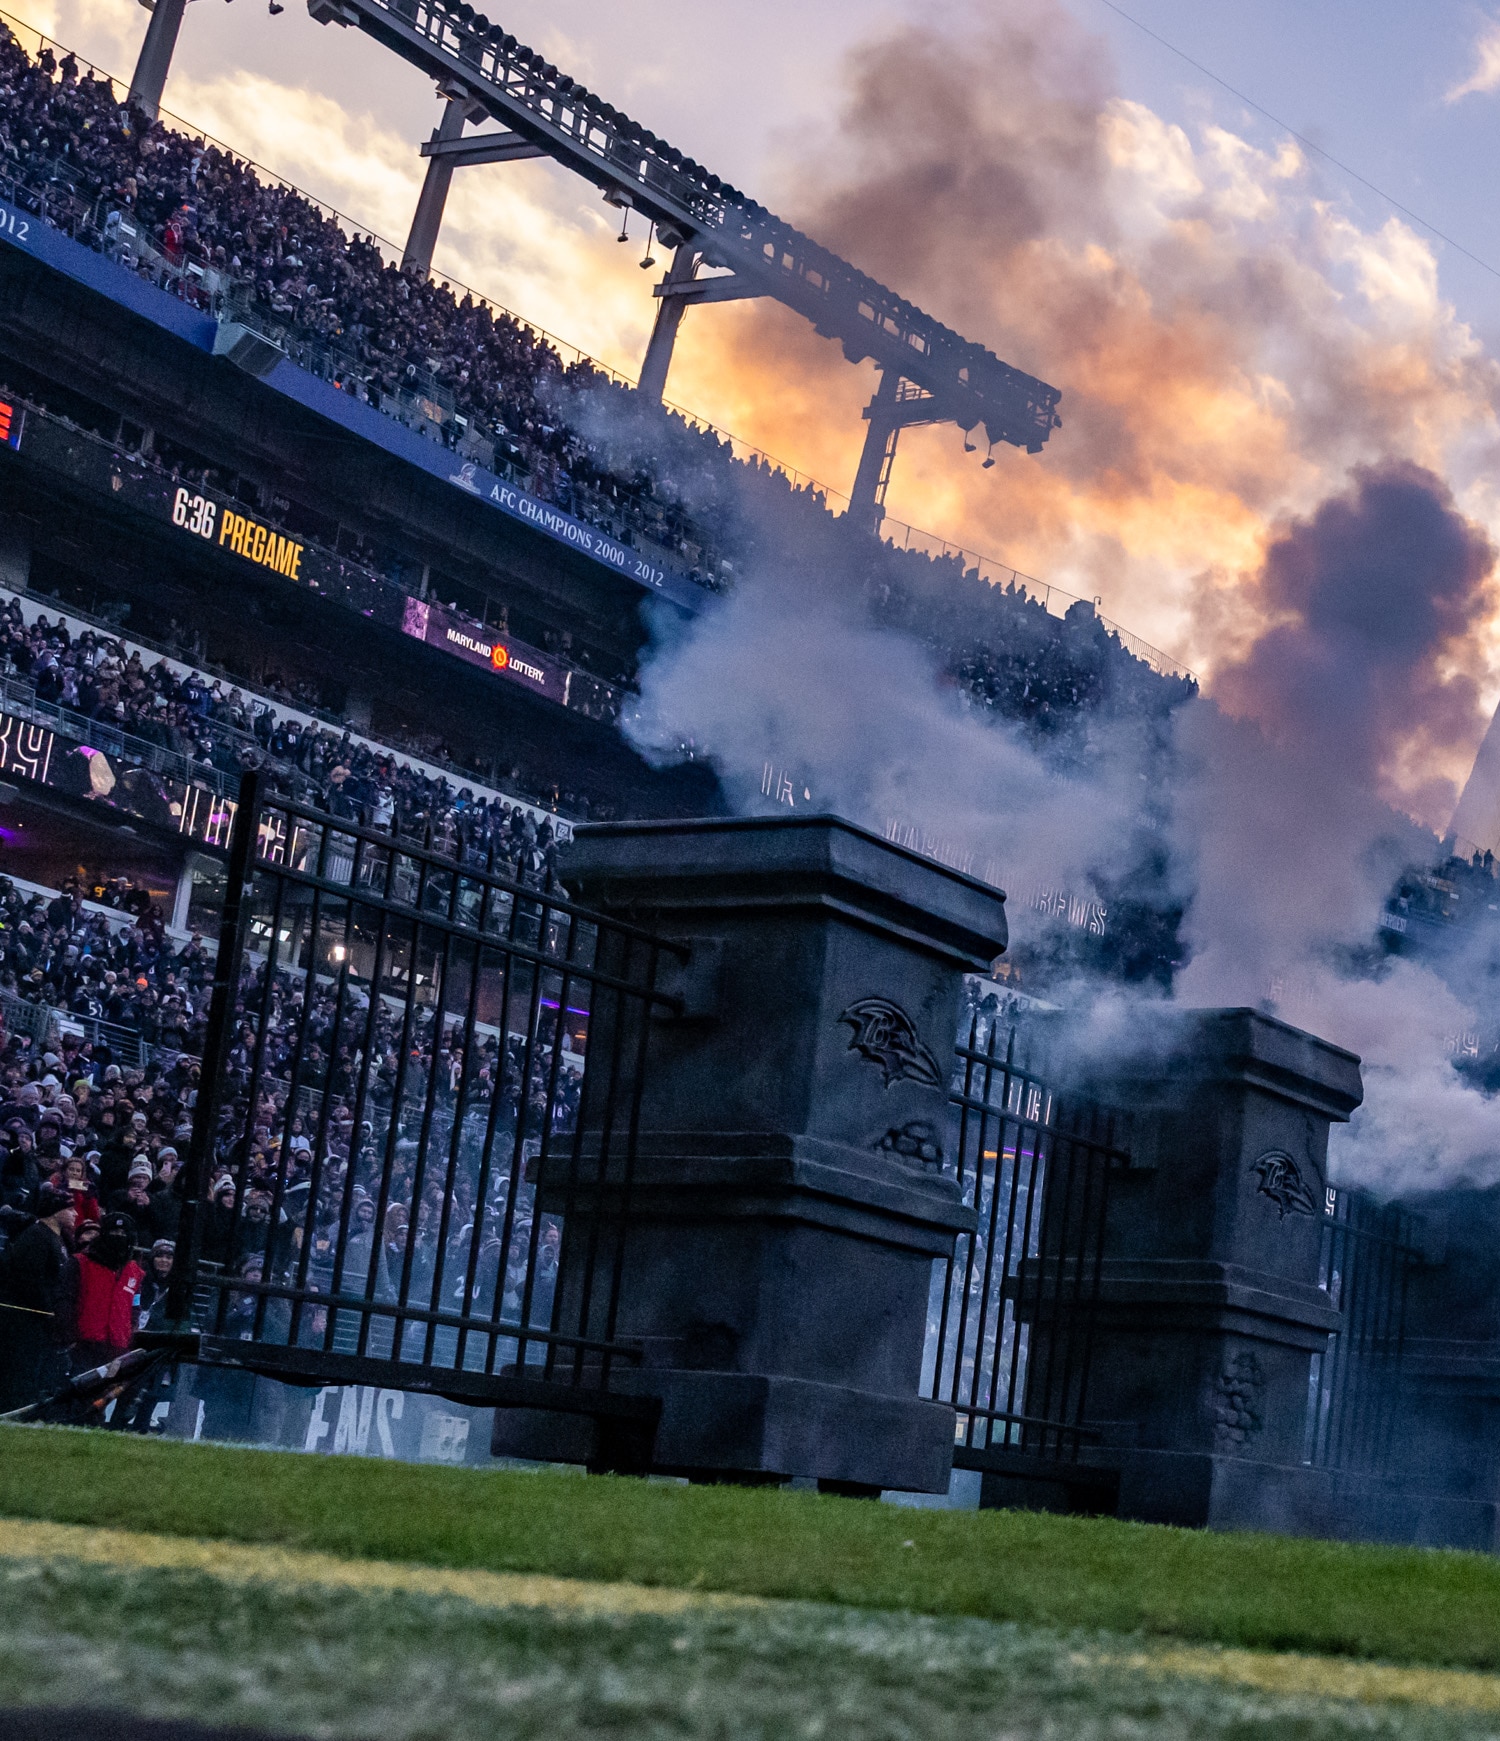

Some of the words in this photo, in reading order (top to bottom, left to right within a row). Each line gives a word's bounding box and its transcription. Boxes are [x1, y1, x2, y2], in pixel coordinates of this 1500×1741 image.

[172, 487, 216, 540] 6:36
[219, 509, 304, 581] PREGAME
[490, 484, 516, 509] AFC
[518, 499, 592, 550] CHAMPIONS
[595, 539, 624, 566] 2000
[635, 560, 664, 587] 2012
[447, 628, 491, 658] MARYLAND
[508, 656, 544, 682] LOTTERY
